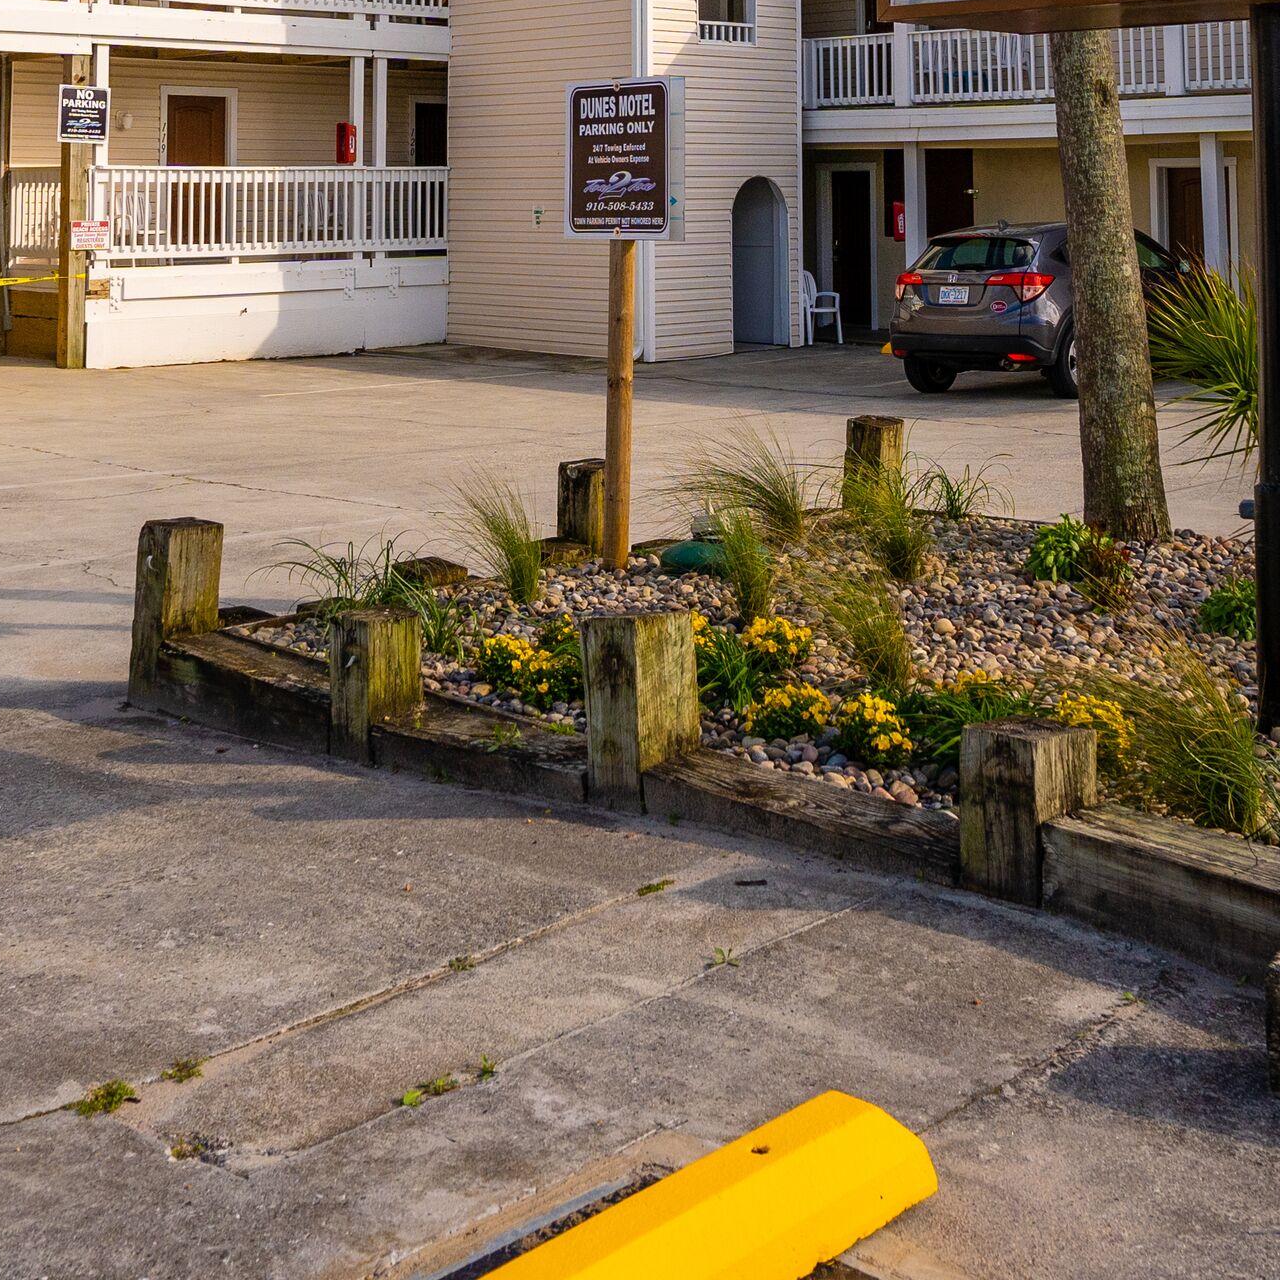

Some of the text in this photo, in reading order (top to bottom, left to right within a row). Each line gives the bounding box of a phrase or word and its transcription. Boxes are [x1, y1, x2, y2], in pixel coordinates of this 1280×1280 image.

[76, 89, 94, 100] NO
[62, 99, 106, 109] PARKING
[580, 93, 656, 119] DUNES MOTEL
[579, 121, 655, 136] PARKING ONLY
[604, 144, 622, 153] Towing
[623, 142, 646, 151] Enforced
[594, 156, 611, 164] Vehicle
[611, 155, 629, 163] Owners
[629, 154, 650, 164] Expense
[585, 201, 655, 211] 910-508-5433
[574, 217, 664, 225] TOWN PARKING PERMIT NOT HONORED HERE
